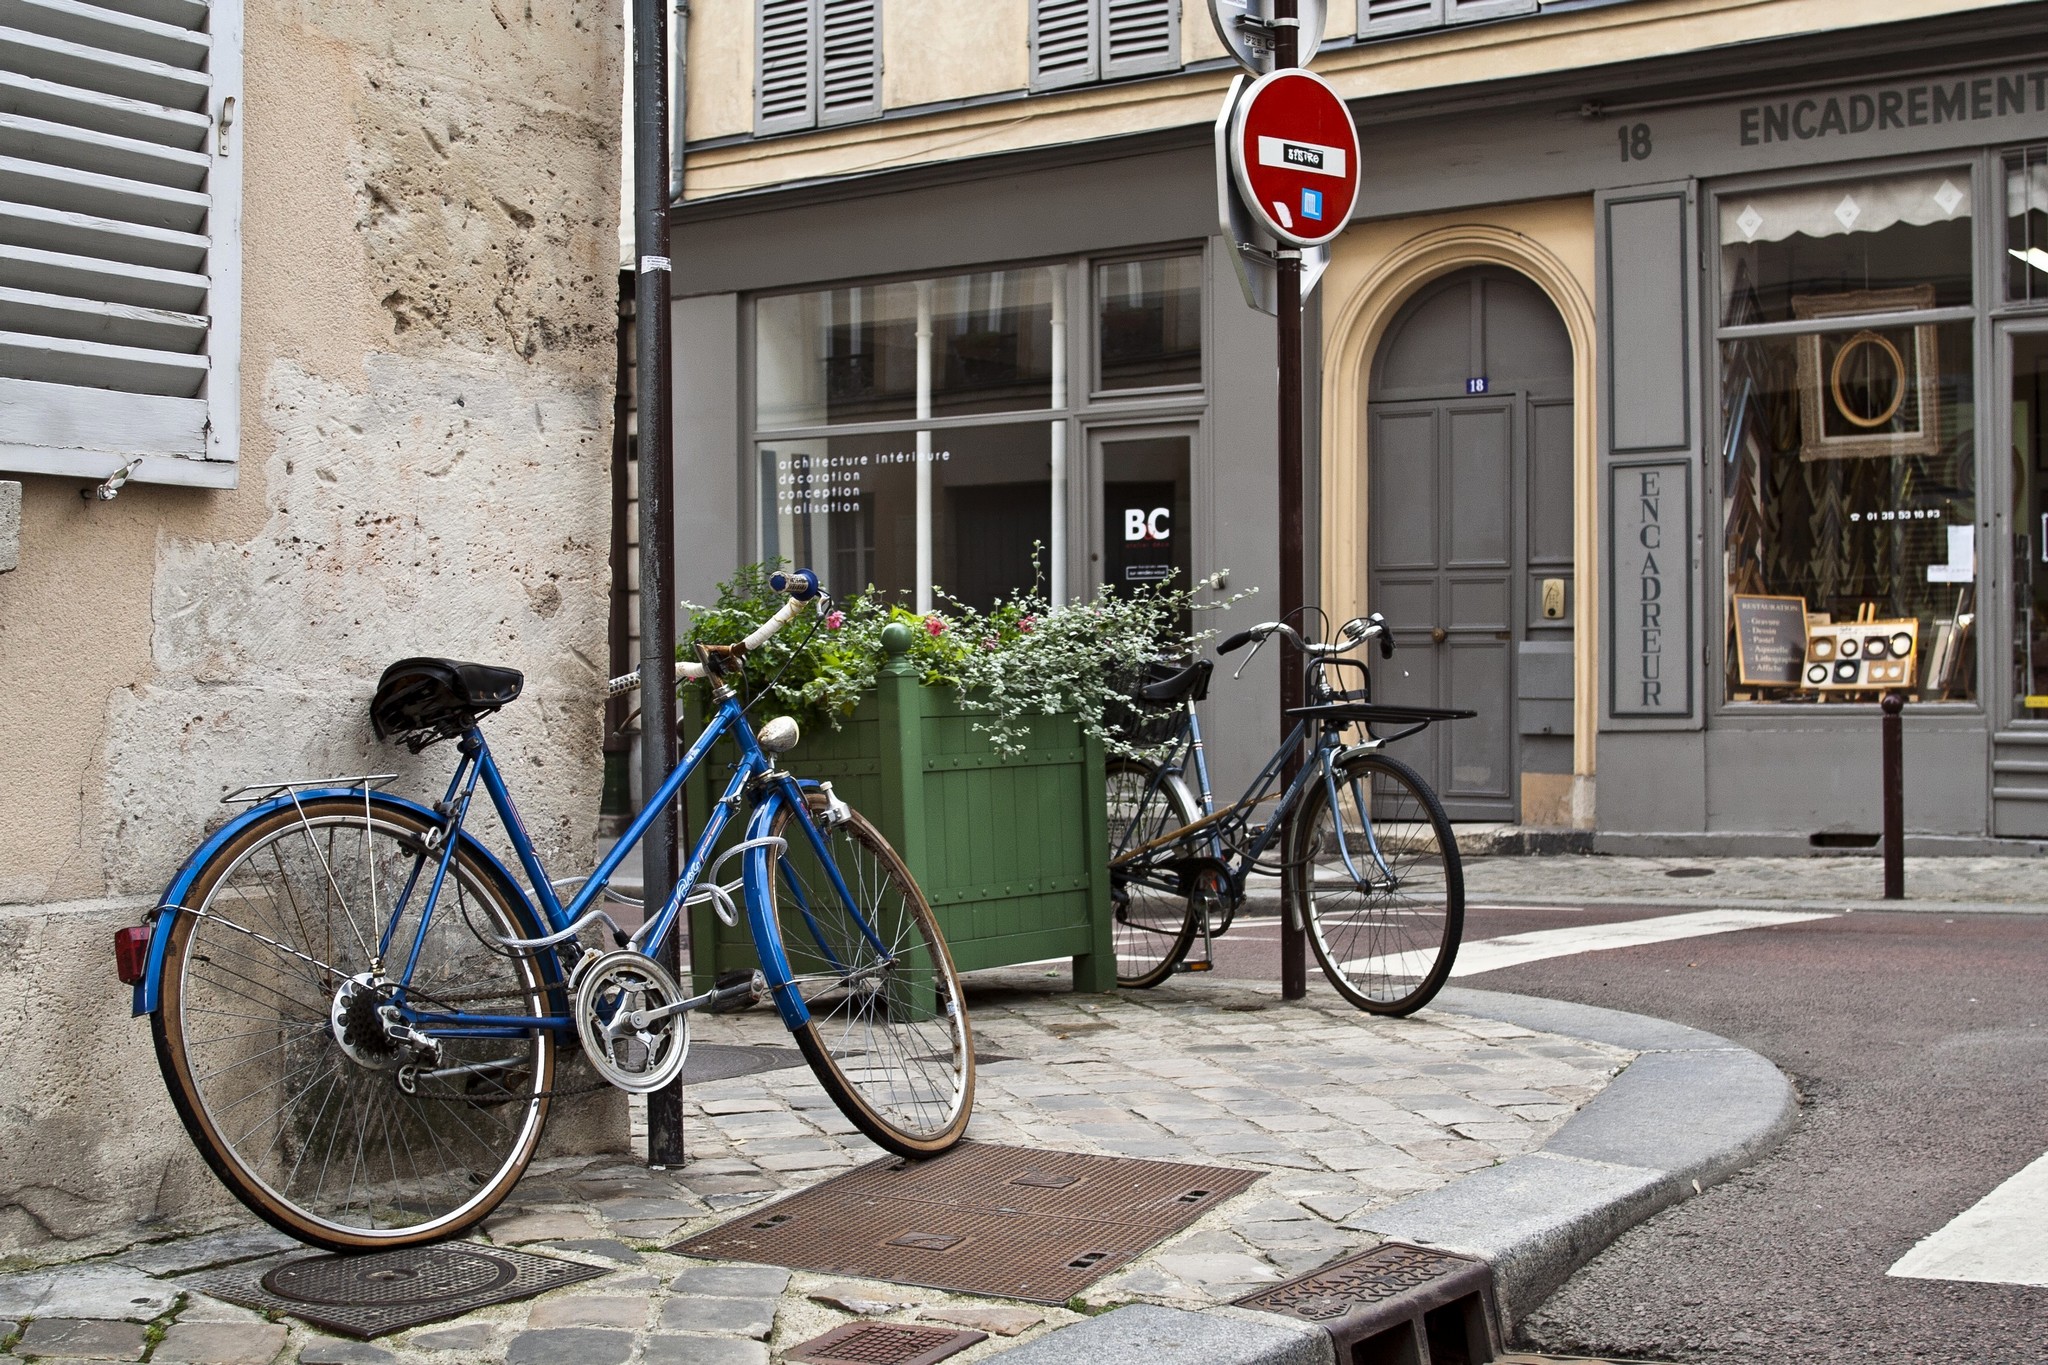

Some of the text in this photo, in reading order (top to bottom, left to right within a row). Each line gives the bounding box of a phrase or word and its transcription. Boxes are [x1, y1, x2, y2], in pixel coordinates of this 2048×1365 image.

[1740, 71, 2048, 146] ENCADREMENT
[1618, 123, 1652, 162] 18
[1470, 378, 1484, 393] 18
[778, 450, 951, 470] architecture intérieure
[778, 471, 861, 485] décoration
[778, 486, 861, 499] conception
[778, 501, 861, 515] réalisation
[1866, 511, 1878, 521] 01
[1639, 471, 1662, 706] ENCADREUR
